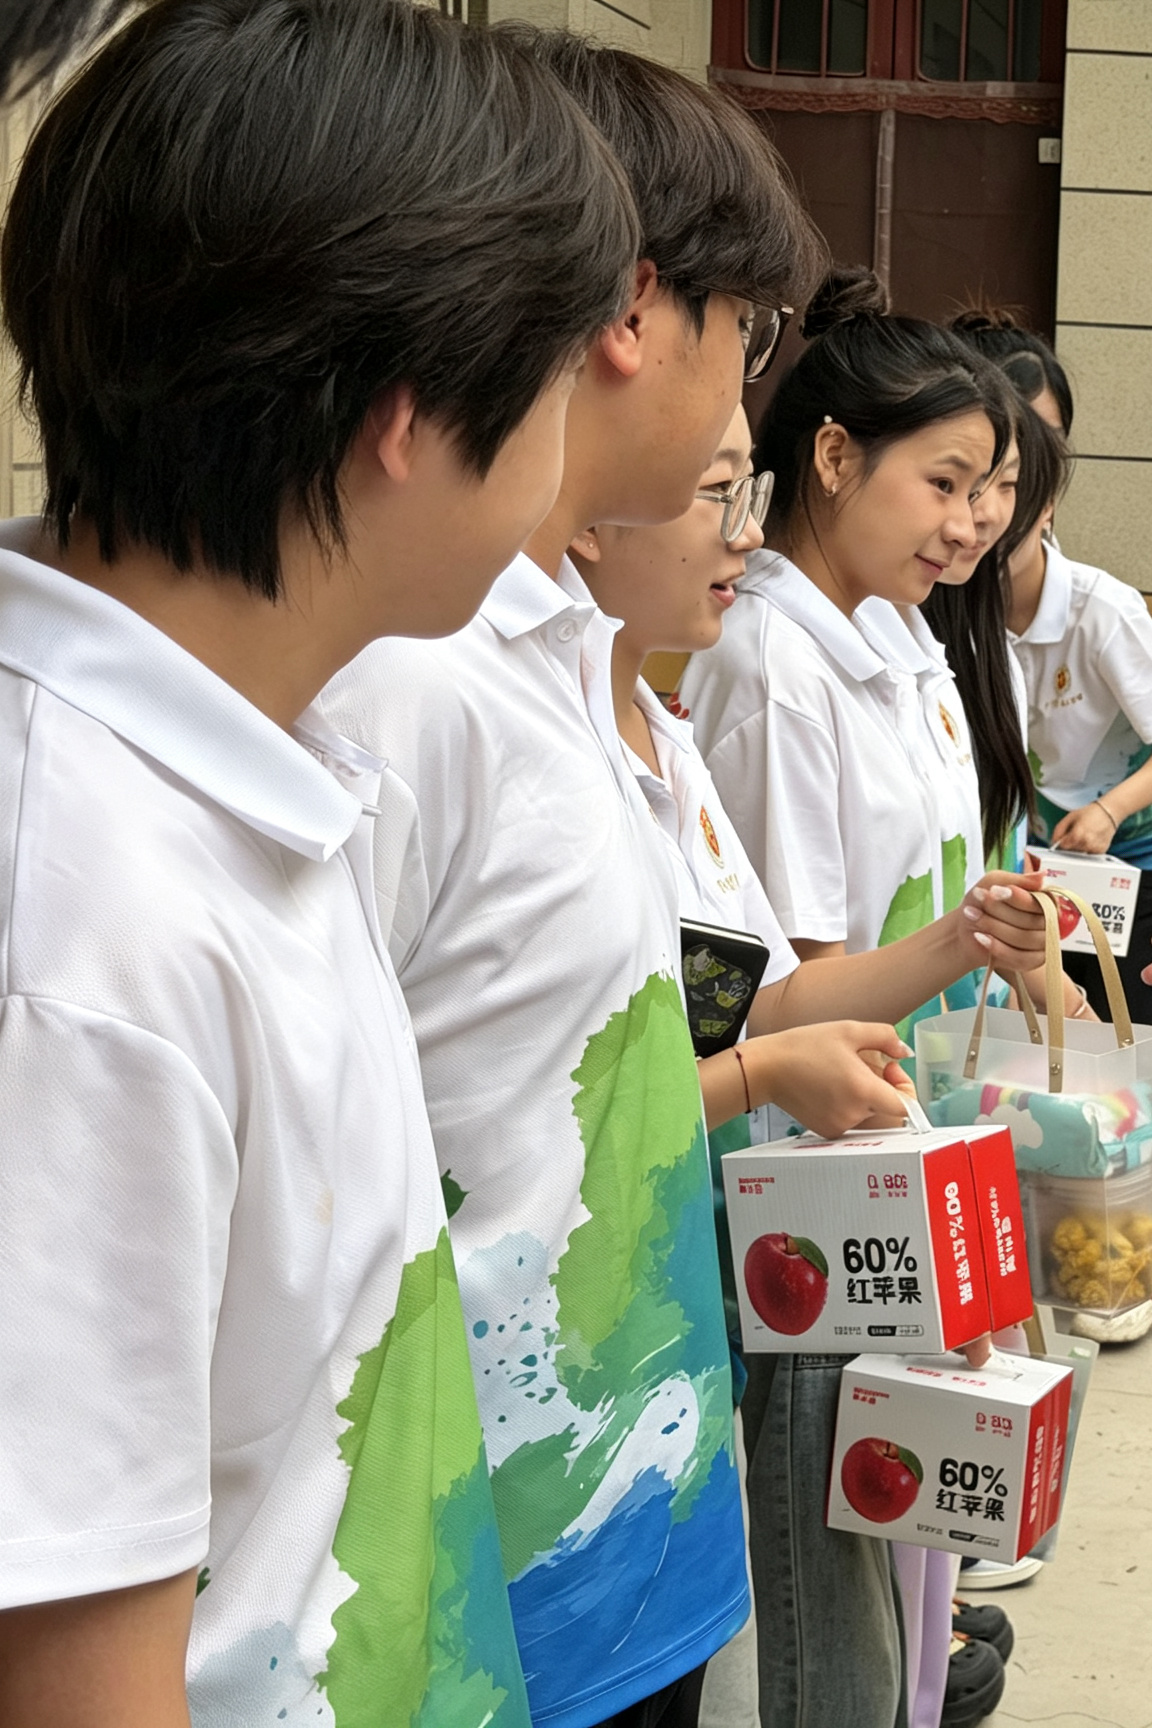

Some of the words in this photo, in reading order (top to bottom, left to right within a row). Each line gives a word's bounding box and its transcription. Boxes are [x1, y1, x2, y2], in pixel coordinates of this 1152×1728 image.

[843, 1237, 918, 1274] 60%
[847, 1276, 922, 1305] 红苹果
[939, 1458, 1008, 1496] 60%
[935, 1489, 1005, 1521] 红苹果
